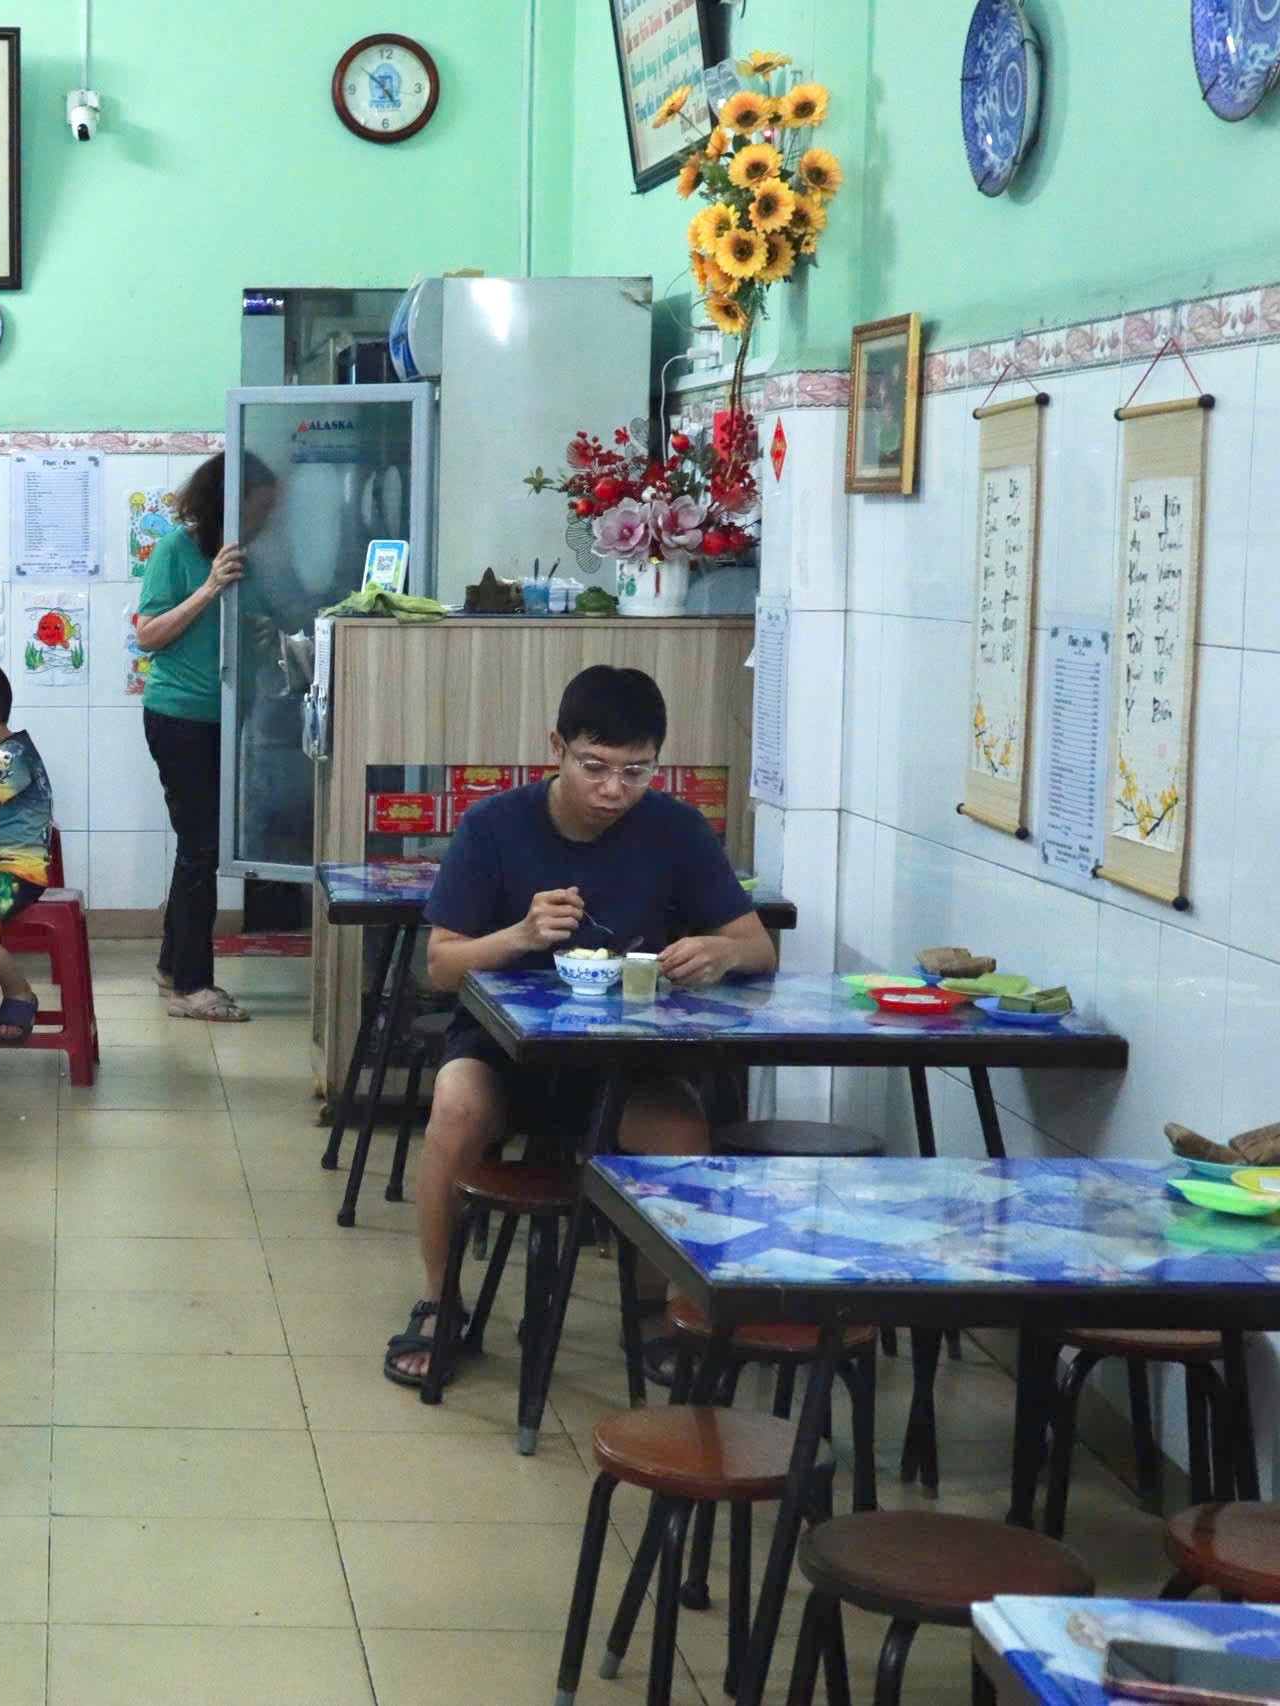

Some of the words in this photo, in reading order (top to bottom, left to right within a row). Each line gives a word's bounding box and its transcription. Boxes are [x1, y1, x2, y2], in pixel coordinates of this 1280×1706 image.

[379, 48, 393, 60] 12
[348, 84, 356, 95] 9
[414, 83, 423, 94] 3
[382, 118, 390, 129] 6
[309, 420, 354, 431] ALASKA
